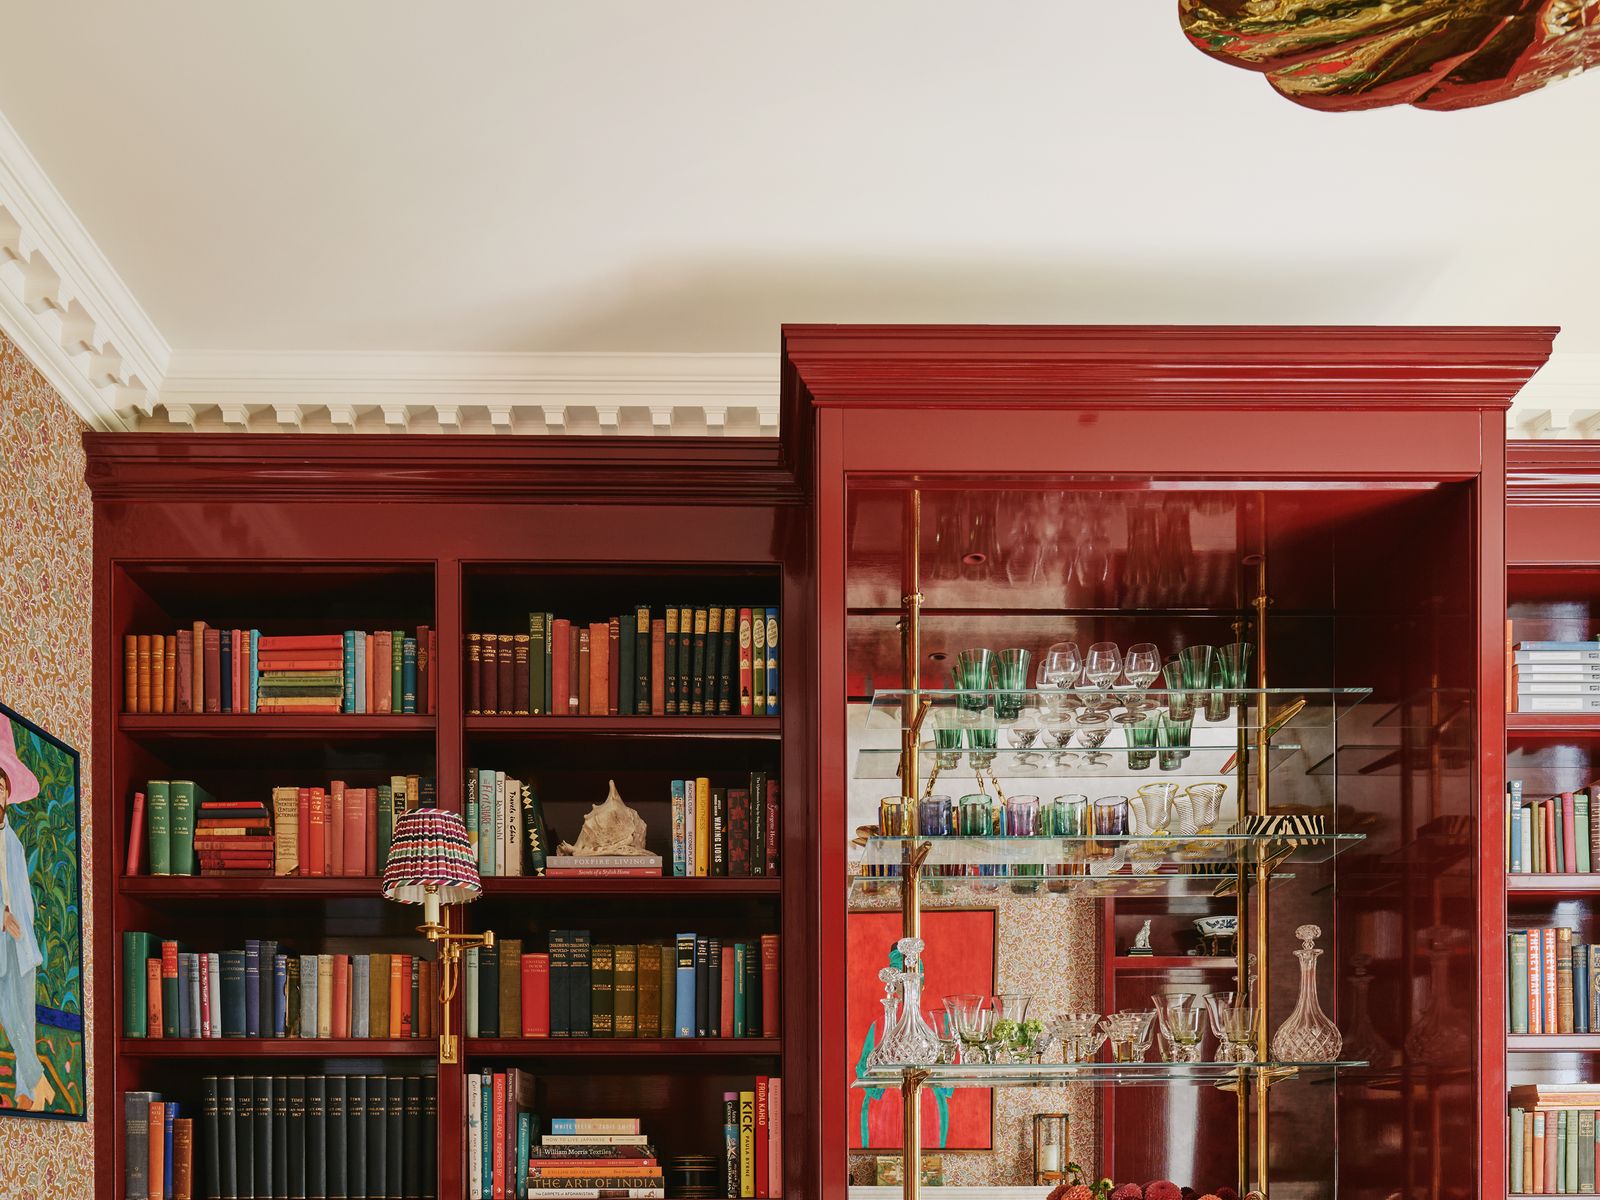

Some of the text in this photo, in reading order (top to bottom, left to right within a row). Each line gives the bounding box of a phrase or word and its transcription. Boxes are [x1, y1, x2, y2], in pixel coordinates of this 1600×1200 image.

[468, 779, 476, 816] Spectrum
[509, 825, 517, 844] China
[758, 1082, 766, 1126] FRIDA KAHLO
[742, 1101, 753, 1133] KICK
[496, 1168, 502, 1177] BY
[533, 1179, 657, 1188] THE ART OF INDIA
